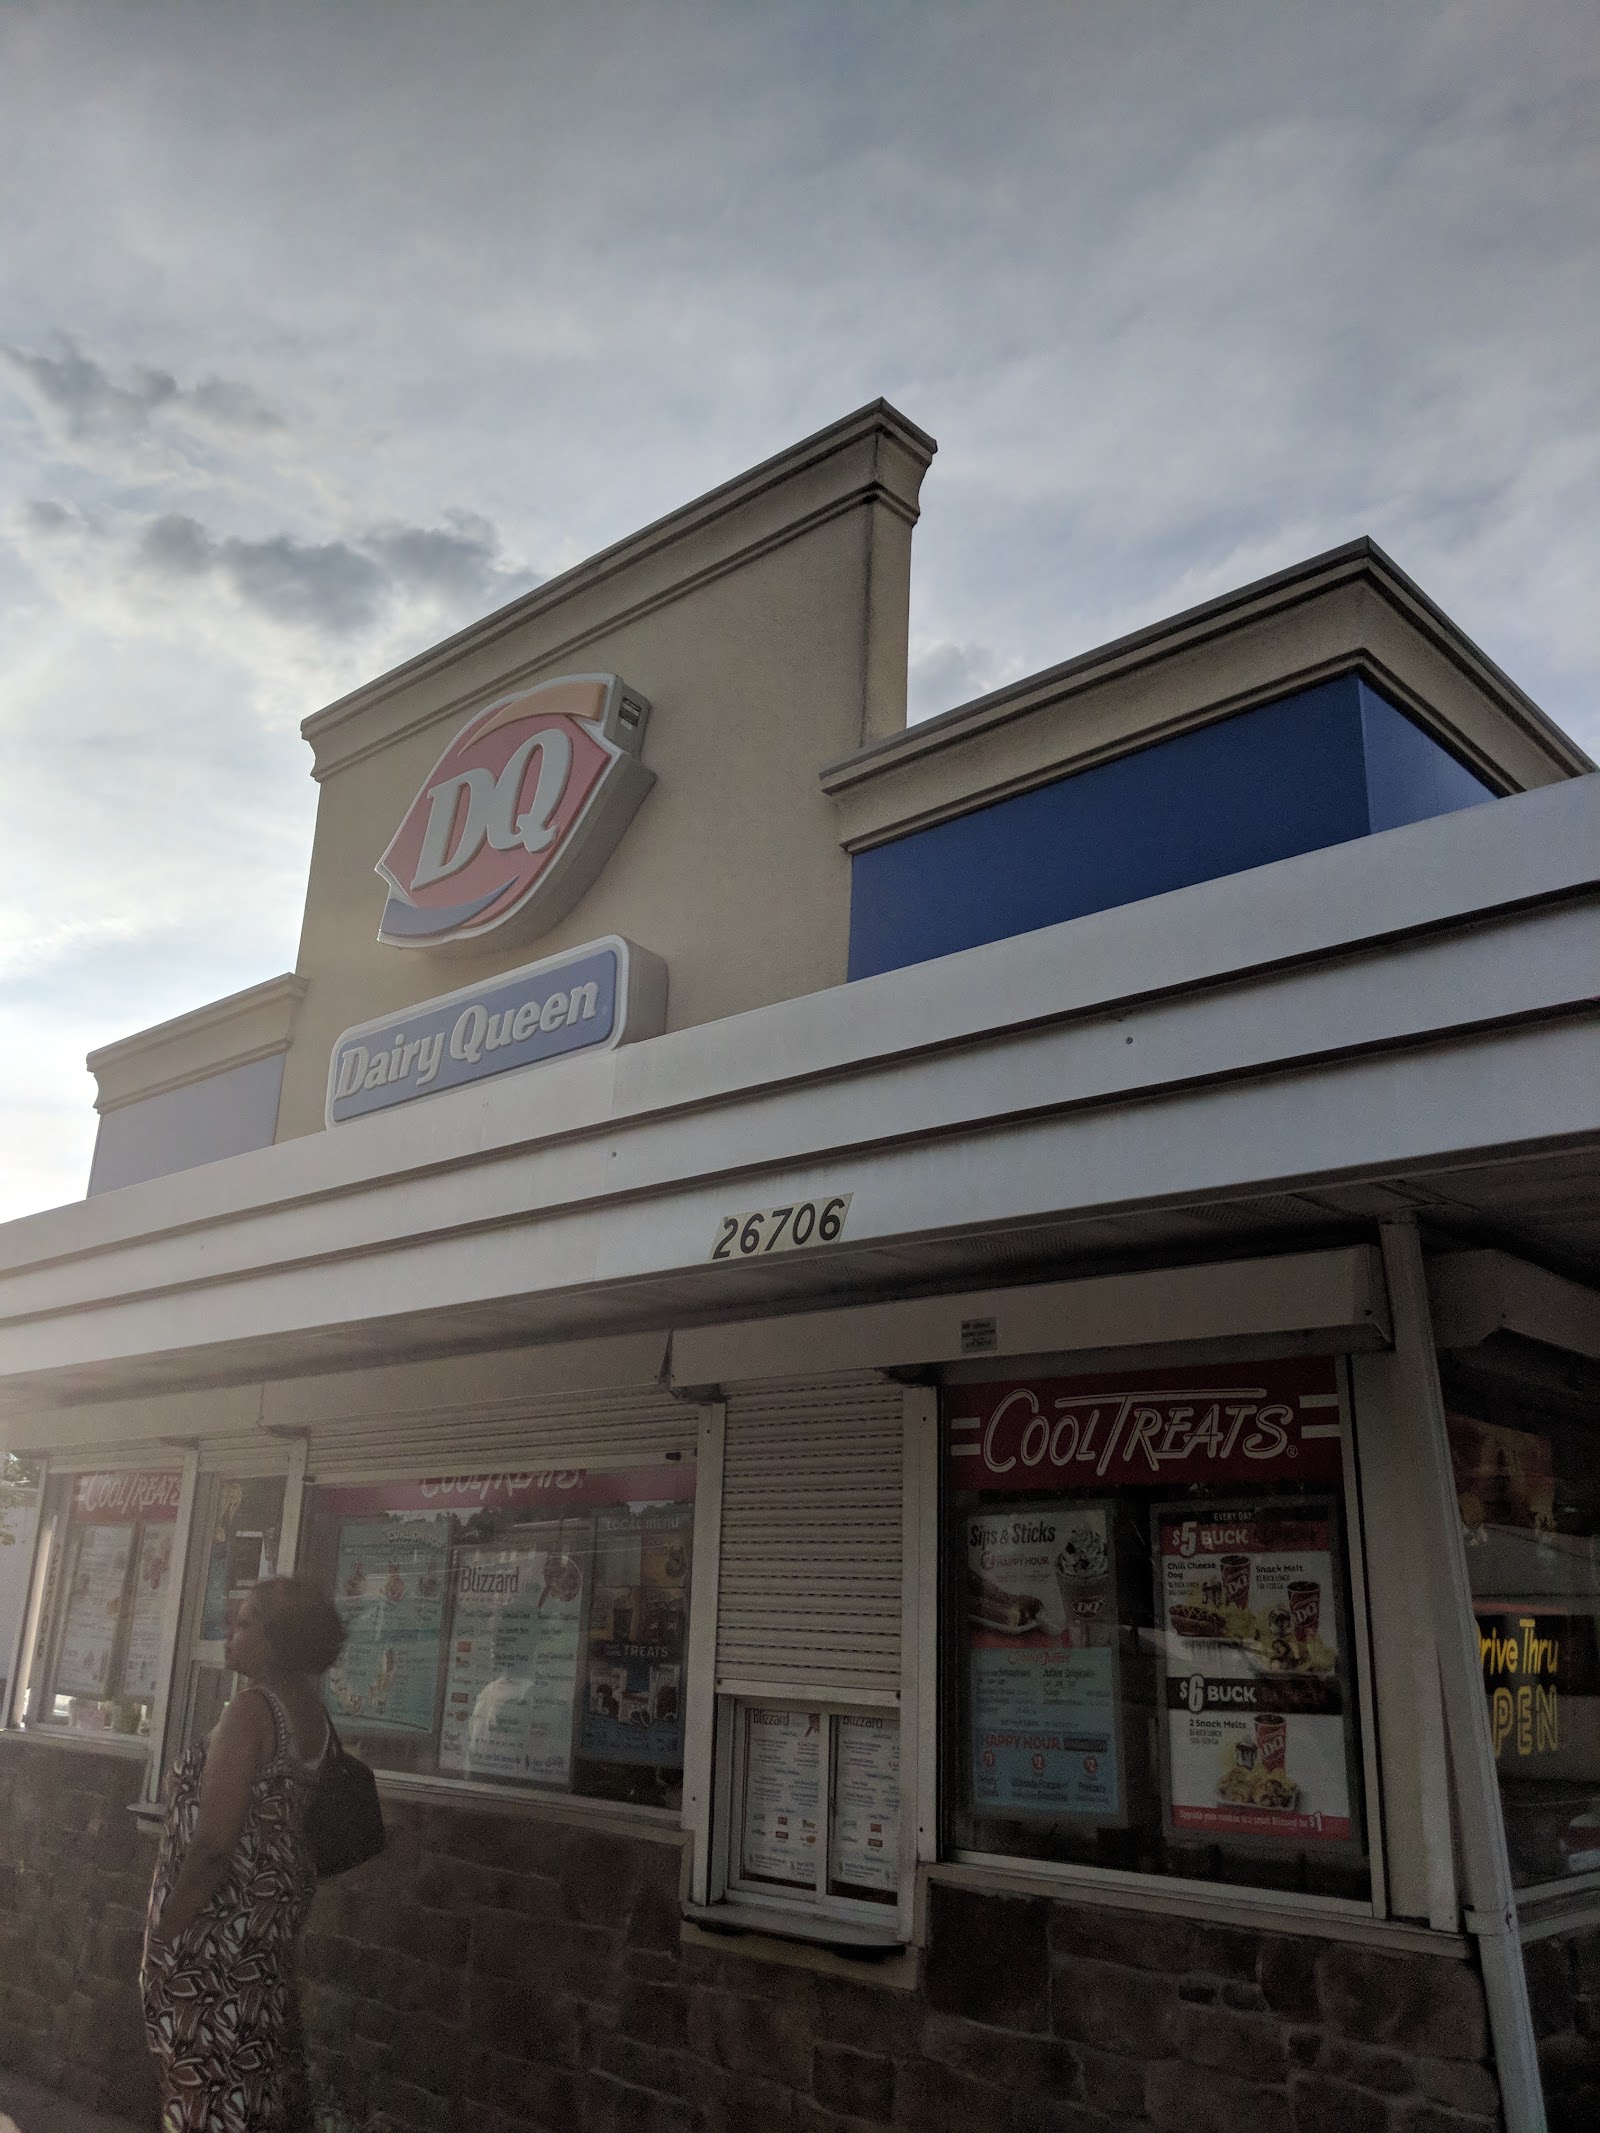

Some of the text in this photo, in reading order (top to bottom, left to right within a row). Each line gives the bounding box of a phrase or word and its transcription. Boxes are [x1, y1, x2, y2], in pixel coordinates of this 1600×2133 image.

[410, 728, 573, 890] DQ
[334, 980, 598, 1100] Dairy Queen
[712, 1198, 846, 1260] 26706
[606, 1517, 641, 1531] LOCAL
[1214, 1512, 1238, 1522] EVERY
[970, 1521, 1056, 1549] Sips & Sticks
[1172, 1521, 1198, 1557] $5
[1201, 1528, 1249, 1546] BUCK
[1024, 1556, 1049, 1565] HOUR
[1187, 1562, 1216, 1570] Cheese
[1255, 1564, 1303, 1573] Snack Melt
[460, 1565, 520, 1595] Blizzard
[1167, 1571, 1183, 1580] Dog
[623, 1644, 669, 1658] TREATS
[1477, 1618, 1559, 1676] rive Thru
[1179, 1674, 1204, 1712] $6
[1207, 1685, 1257, 1702] BUCK
[1196, 1719, 1221, 1727] Snack
[1223, 1721, 1247, 1729] Melts
[1493, 1684, 1558, 1757] PEN
[1023, 1735, 1060, 1750] HOUR
